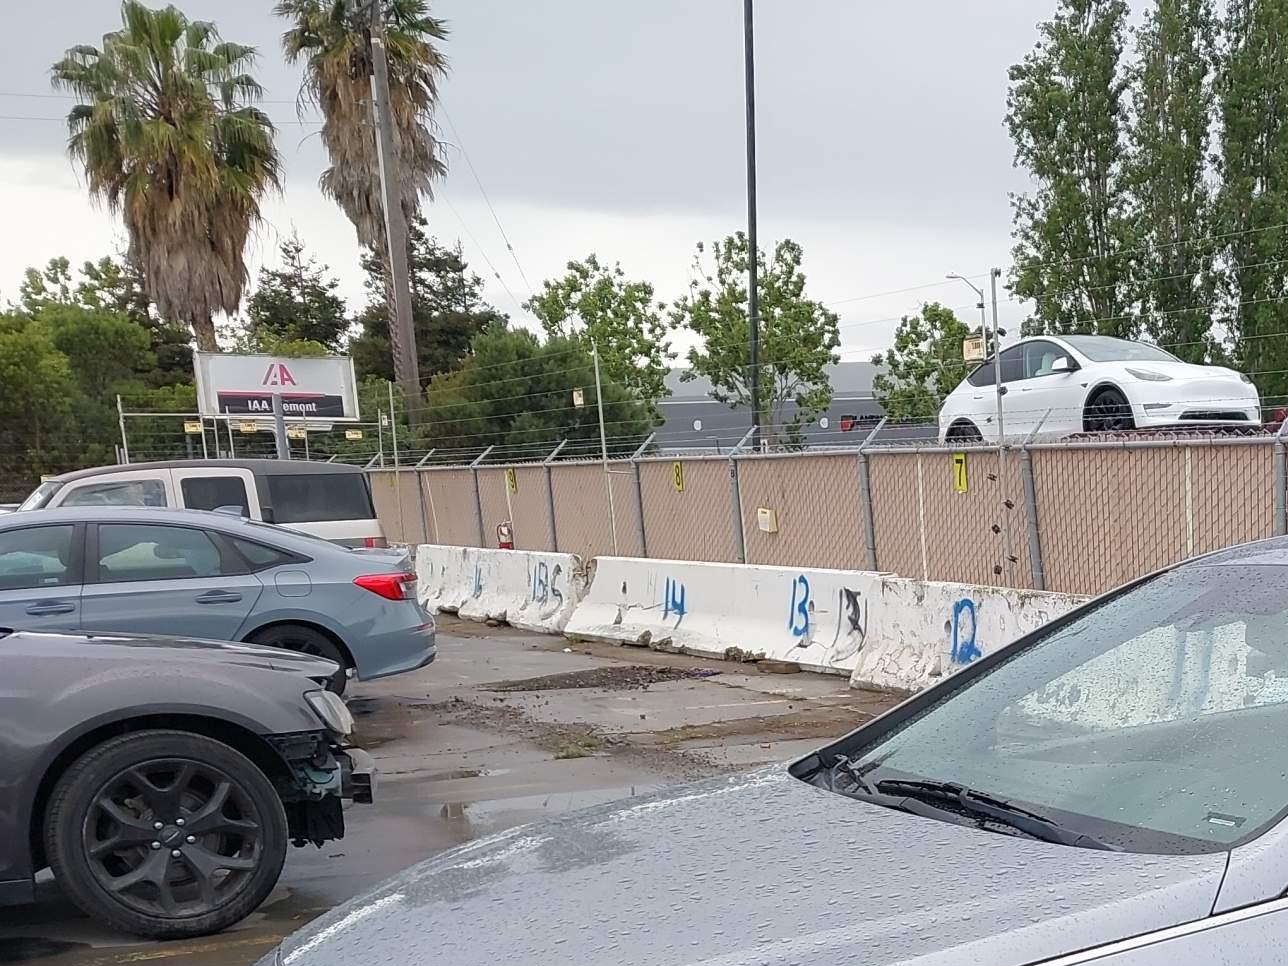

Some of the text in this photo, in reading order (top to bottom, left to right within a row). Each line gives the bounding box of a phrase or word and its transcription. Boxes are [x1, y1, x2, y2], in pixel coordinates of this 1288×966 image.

[247, 400, 270, 412] IAA
[674, 464, 682, 487] 8
[955, 458, 964, 487] 7
[662, 575, 688, 630] 14
